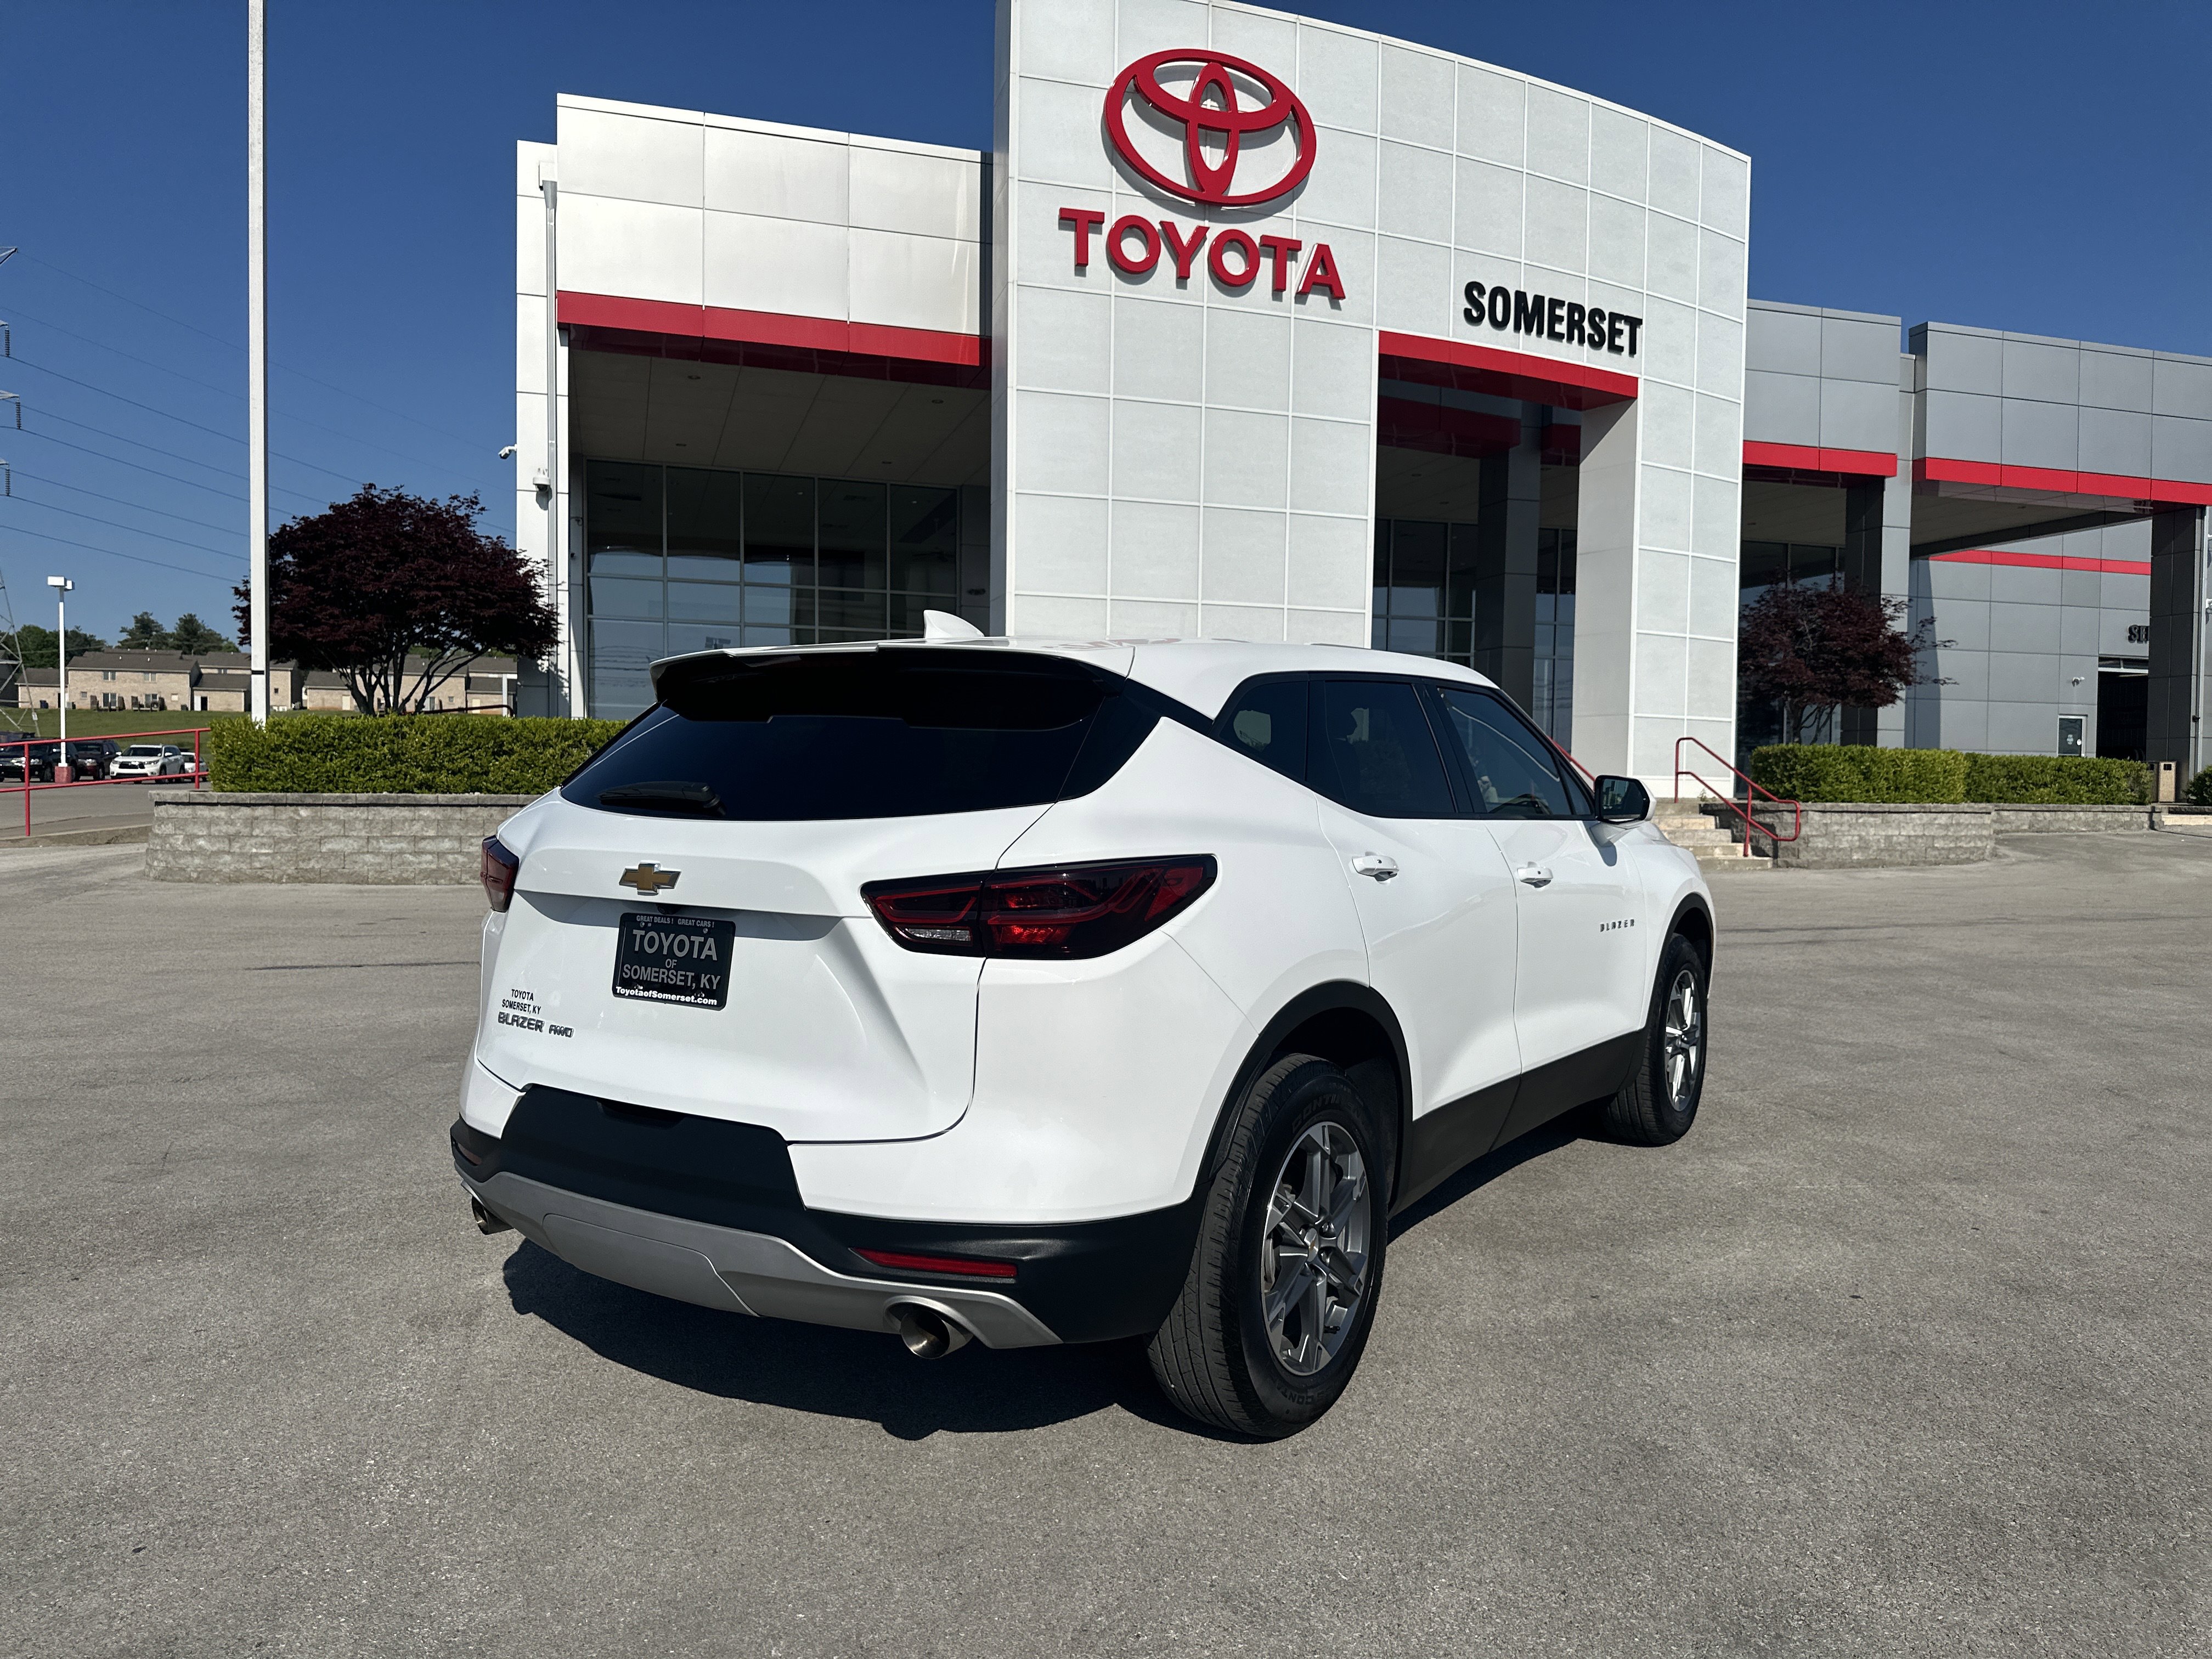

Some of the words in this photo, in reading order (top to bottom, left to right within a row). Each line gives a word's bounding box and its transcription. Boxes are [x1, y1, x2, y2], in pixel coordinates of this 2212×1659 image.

[1058, 206, 1346, 300] TOYOTA
[1463, 280, 1643, 356] SOMERSET
[1600, 919, 1634, 932] BLAZER
[633, 929, 718, 961] TOYOTA
[665, 958, 678, 969] OF
[623, 964, 696, 990] SOMERSET,
[700, 974, 721, 990] KY
[511, 989, 534, 1001] TOYOTA
[616, 986, 717, 1005] ToyotaofSomerset.com
[502, 999, 532, 1014] SOMERSET,
[532, 1005, 541, 1015] KY
[498, 1011, 545, 1032] BLAZER
[549, 1024, 574, 1038] AWD
